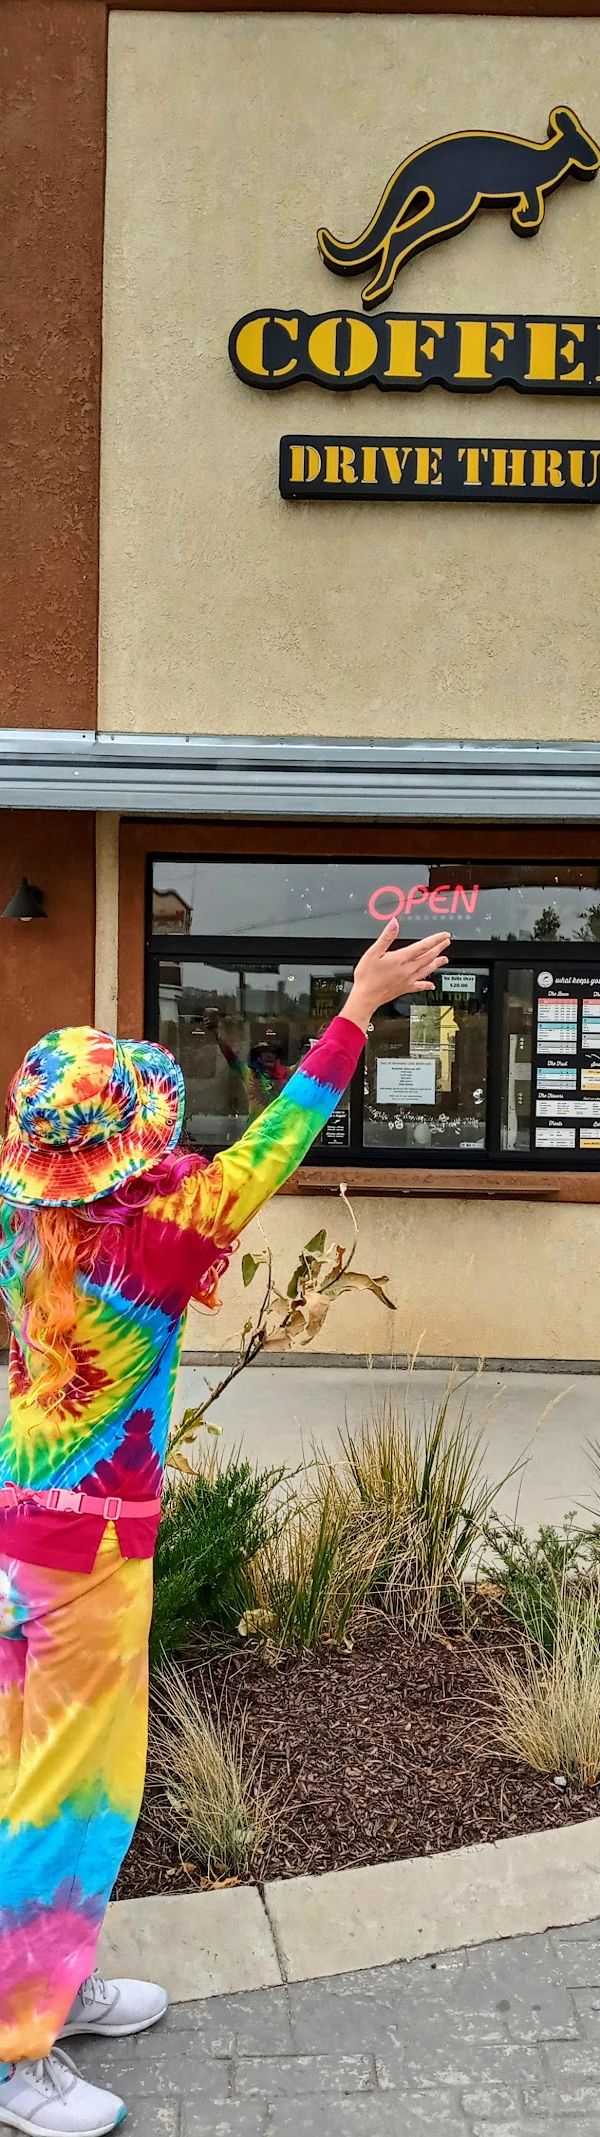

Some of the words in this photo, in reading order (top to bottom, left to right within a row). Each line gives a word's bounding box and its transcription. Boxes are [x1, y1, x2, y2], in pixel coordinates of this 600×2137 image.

[235, 317, 600, 381] COFFE
[289, 445, 443, 486] DRIVE
[458, 448, 600, 488] THRU
[368, 884, 479, 921] OPEN
